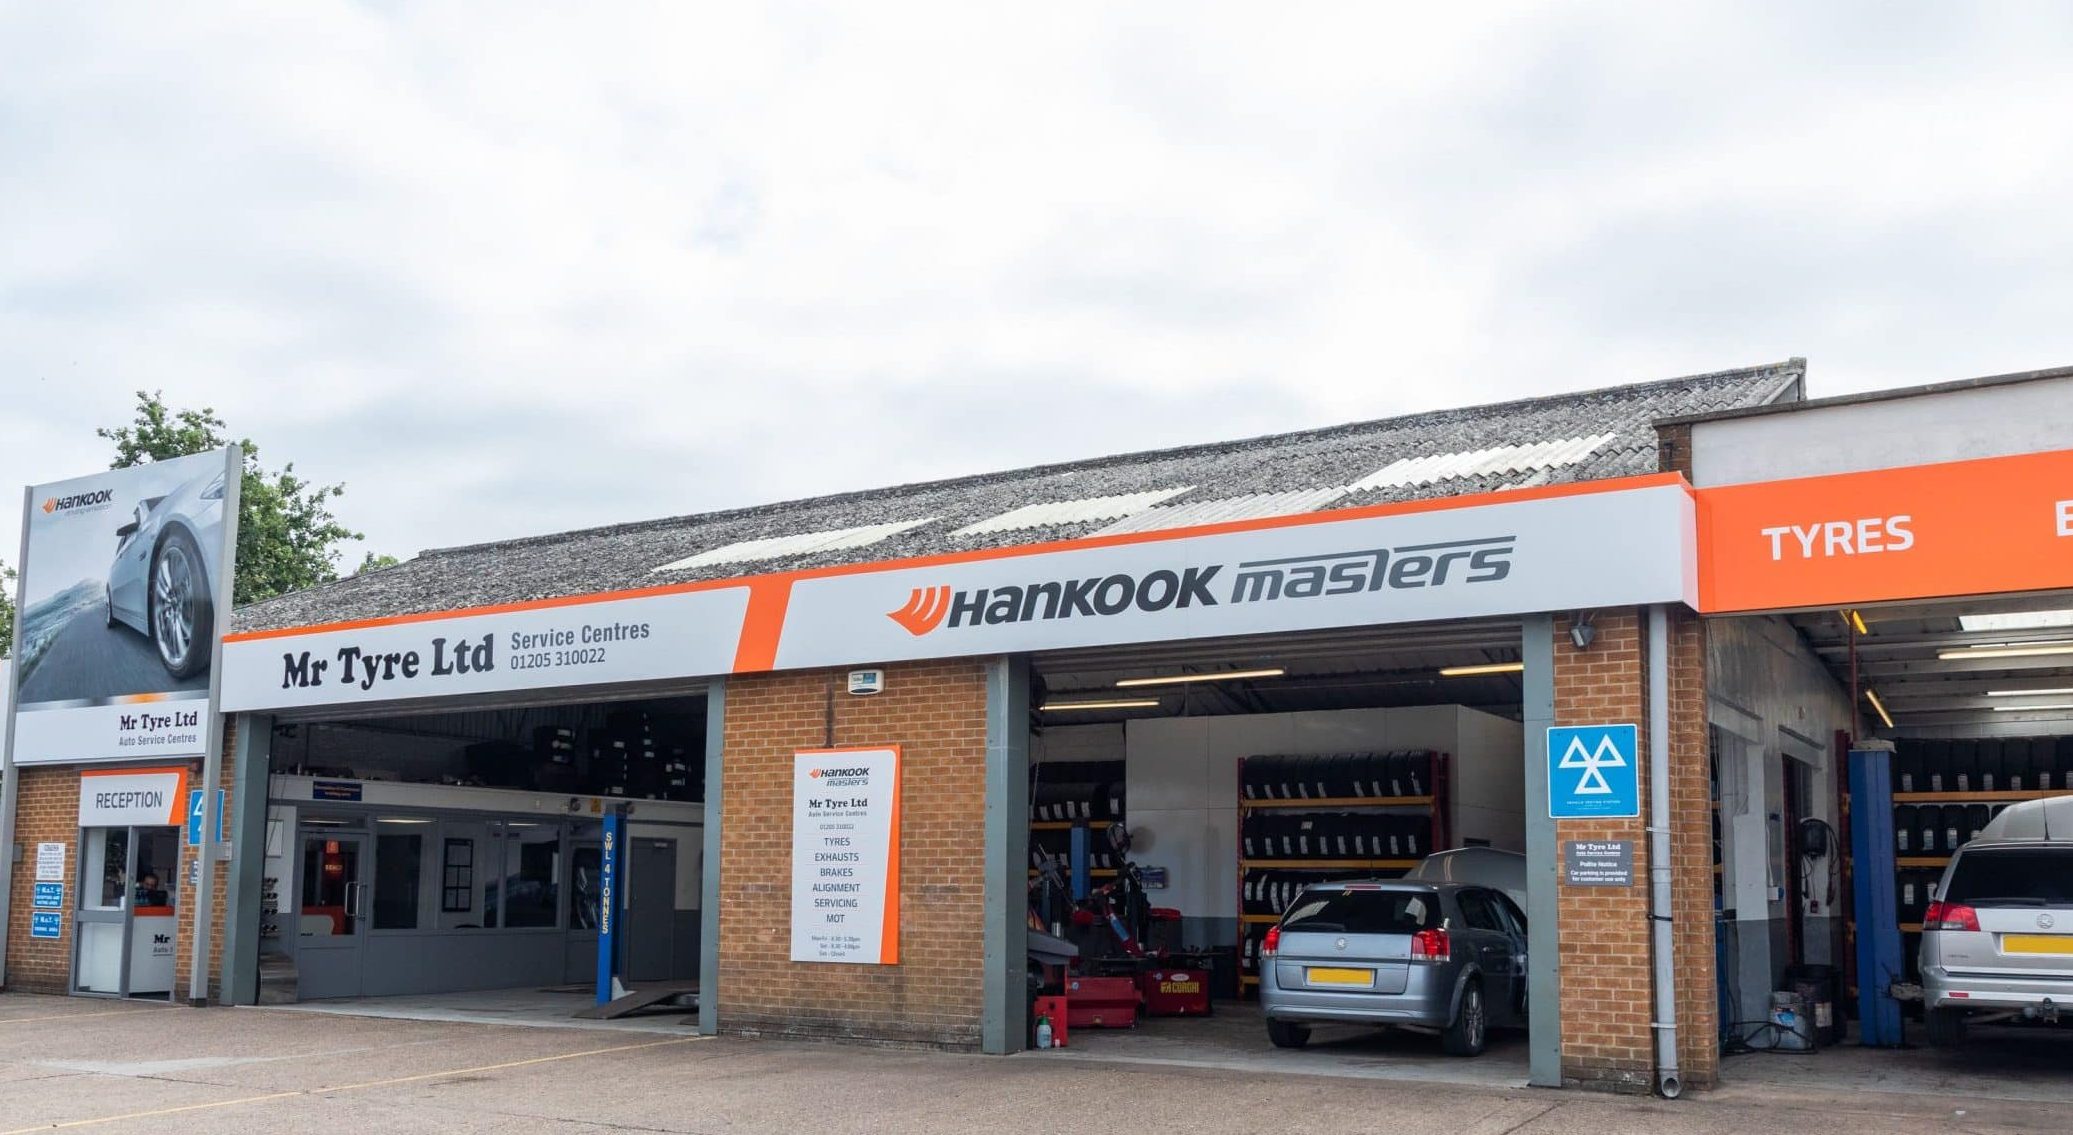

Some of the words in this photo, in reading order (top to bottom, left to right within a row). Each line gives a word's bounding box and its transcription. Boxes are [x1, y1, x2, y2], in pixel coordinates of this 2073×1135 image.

[1760, 514, 1915, 561] TYRES
[1231, 535, 1517, 604] masters
[511, 627, 575, 651] Service
[581, 622, 651, 644] Centres
[281, 650, 328, 689] Mr
[338, 646, 420, 691] Tyre
[431, 633, 495, 676] Ltd
[511, 651, 552, 671] 01205
[555, 648, 607, 667] 310022
[119, 714, 138, 731] Mr
[141, 713, 172, 732] Tyre
[175, 710, 198, 727] Ltd
[96, 791, 163, 809] RECEPTION
[808, 798, 823, 809] Mr
[825, 798, 848, 810] Tyre
[850, 797, 868, 808] Ltd
[824, 837, 851, 847] TYRES
[814, 852, 860, 862] EXHAUSTS
[604, 863, 611, 874] 4
[820, 867, 853, 877] BRAKES
[812, 883, 861, 893] ALIGNMENT
[602, 877, 611, 935] TONNES
[814, 898, 858, 909] SERVICING
[826, 914, 846, 924] MOT
[153, 933, 171, 944] Mr
